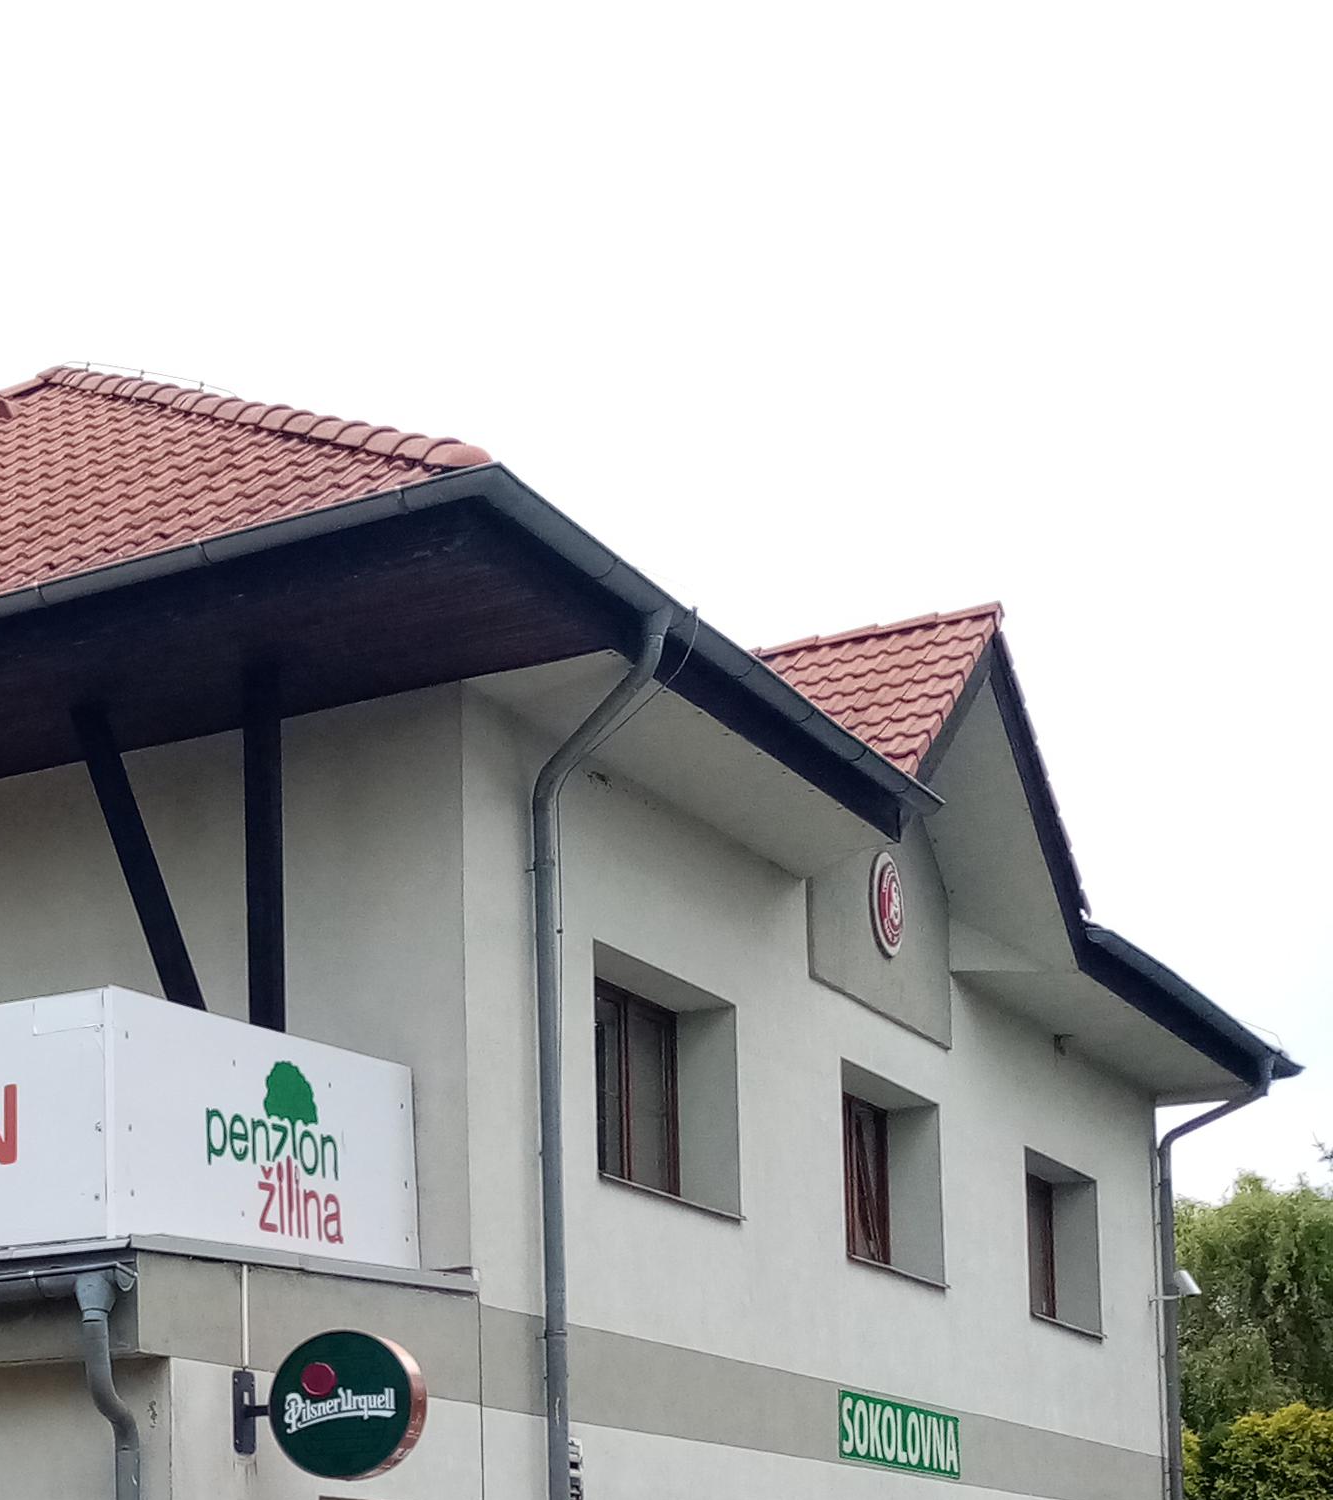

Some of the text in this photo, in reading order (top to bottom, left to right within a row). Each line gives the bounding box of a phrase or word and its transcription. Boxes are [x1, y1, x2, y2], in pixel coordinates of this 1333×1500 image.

[206, 1107, 339, 1181] penzion
[258, 1155, 344, 1244] žilina
[284, 1387, 396, 1434] Pilsner Urquell
[841, 1396, 959, 1473] SOKOLOVNA
